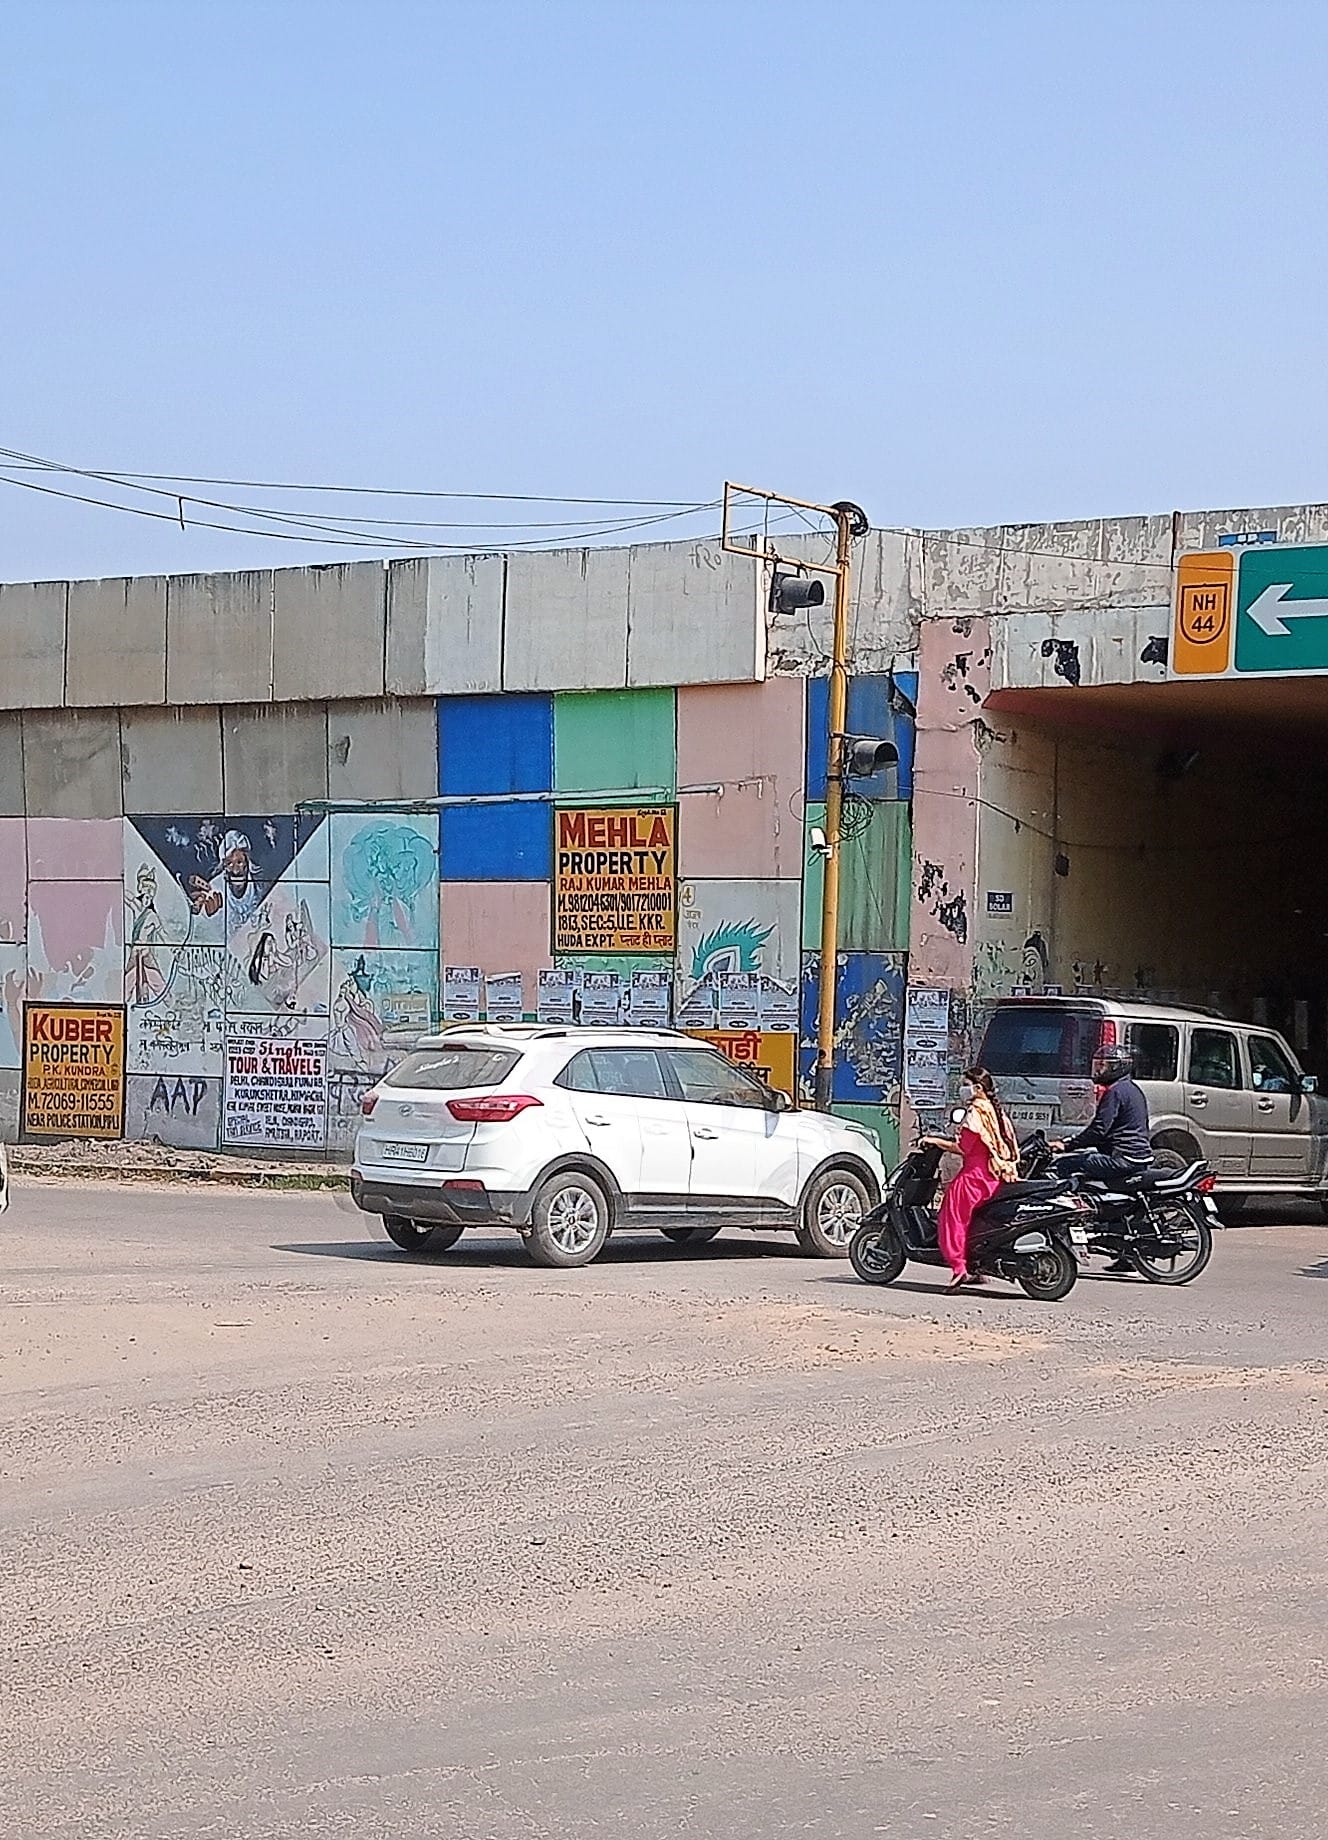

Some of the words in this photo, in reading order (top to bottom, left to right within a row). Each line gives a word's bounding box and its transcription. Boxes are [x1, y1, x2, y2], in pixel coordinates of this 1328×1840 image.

[1193, 593, 1215, 611] NH
[1191, 615, 1215, 633] 44
[559, 812, 670, 848] MEHLA
[559, 851, 667, 875] PROPERTY
[560, 878, 583, 891] RAJ
[586, 878, 625, 891] KUMAR
[628, 878, 672, 891] MEHLA
[558, 934, 583, 947] HUDA
[585, 934, 615, 947] EXPT.
[32, 1013, 113, 1042] KUBER
[30, 1043, 114, 1064] PROPERTY
[259, 1040, 302, 1063] Singh
[43, 1064, 61, 1075] P.K.
[64, 1066, 105, 1076] KUNDRA
[229, 1057, 258, 1074] TOUR
[261, 1058, 272, 1074] &
[272, 1057, 321, 1075] TRAVELS
[150, 1077, 207, 1115] AAP
